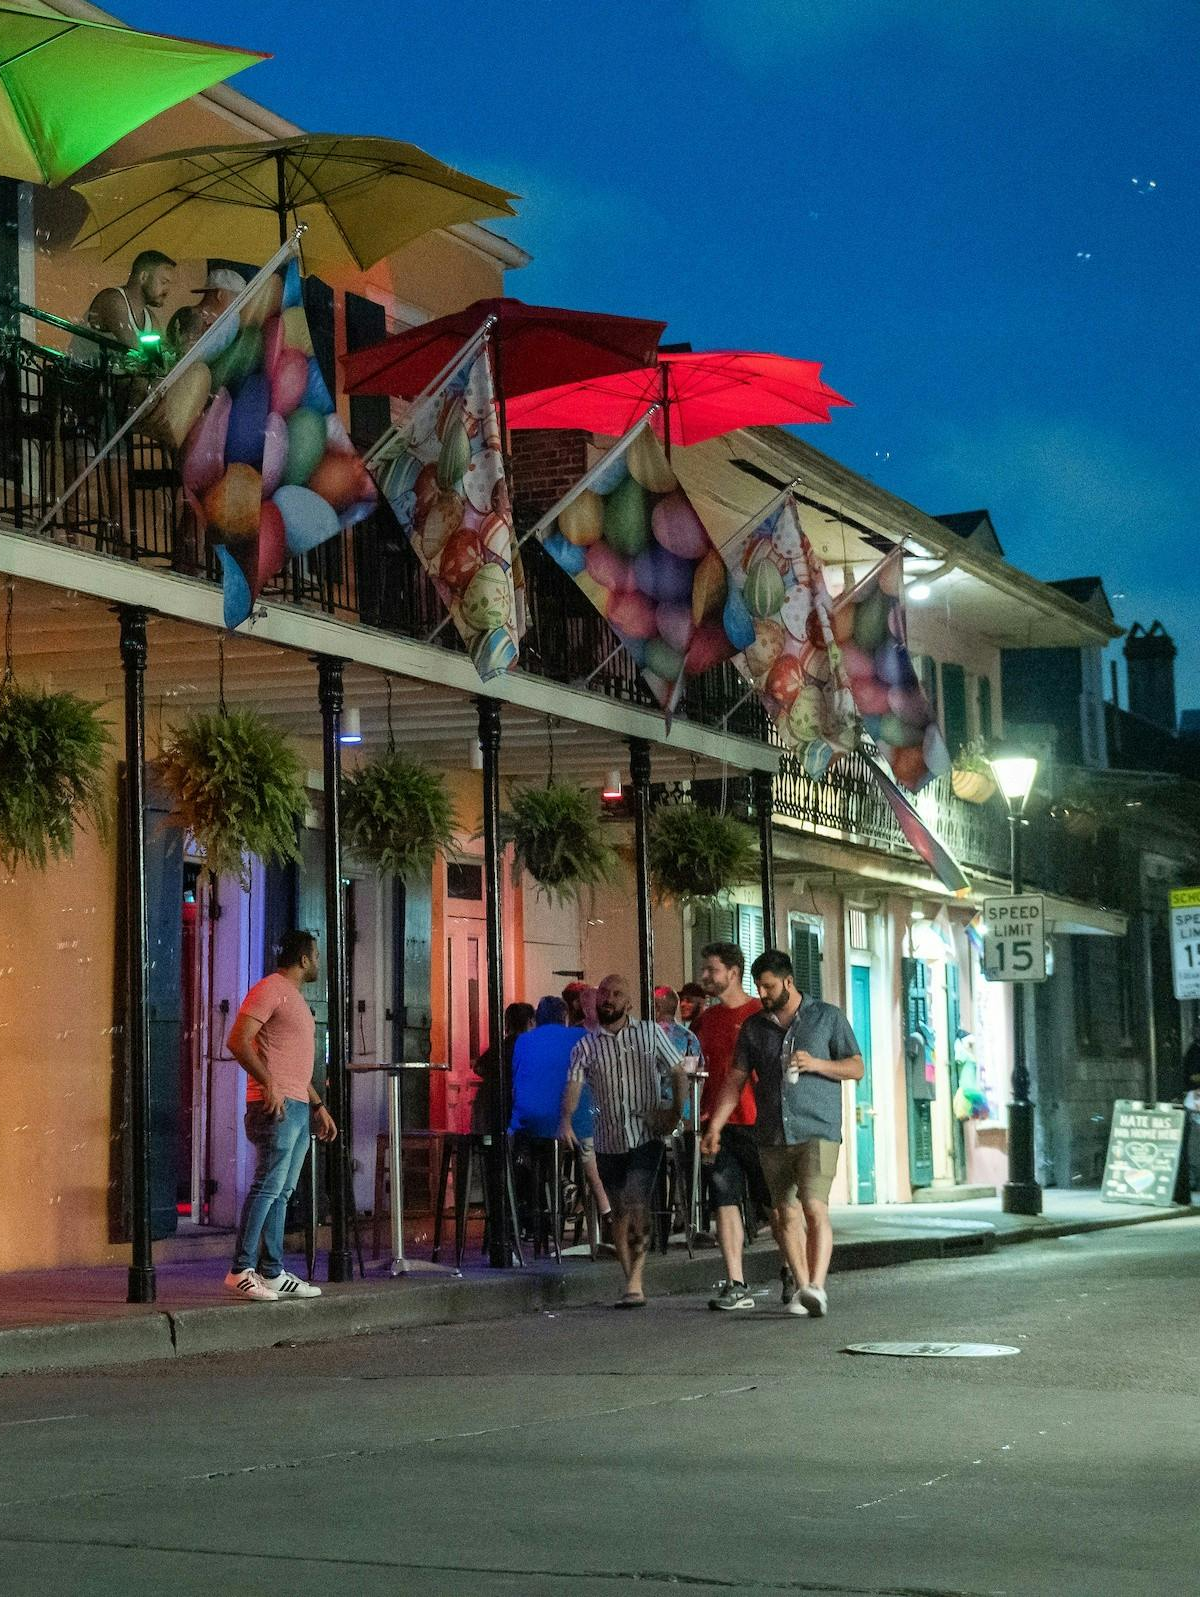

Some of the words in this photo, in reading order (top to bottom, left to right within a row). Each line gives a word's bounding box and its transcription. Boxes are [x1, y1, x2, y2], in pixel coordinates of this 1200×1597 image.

[989, 906, 1039, 920] SPEED
[995, 923, 1033, 937] LIMIT
[996, 941, 1033, 971] 15
